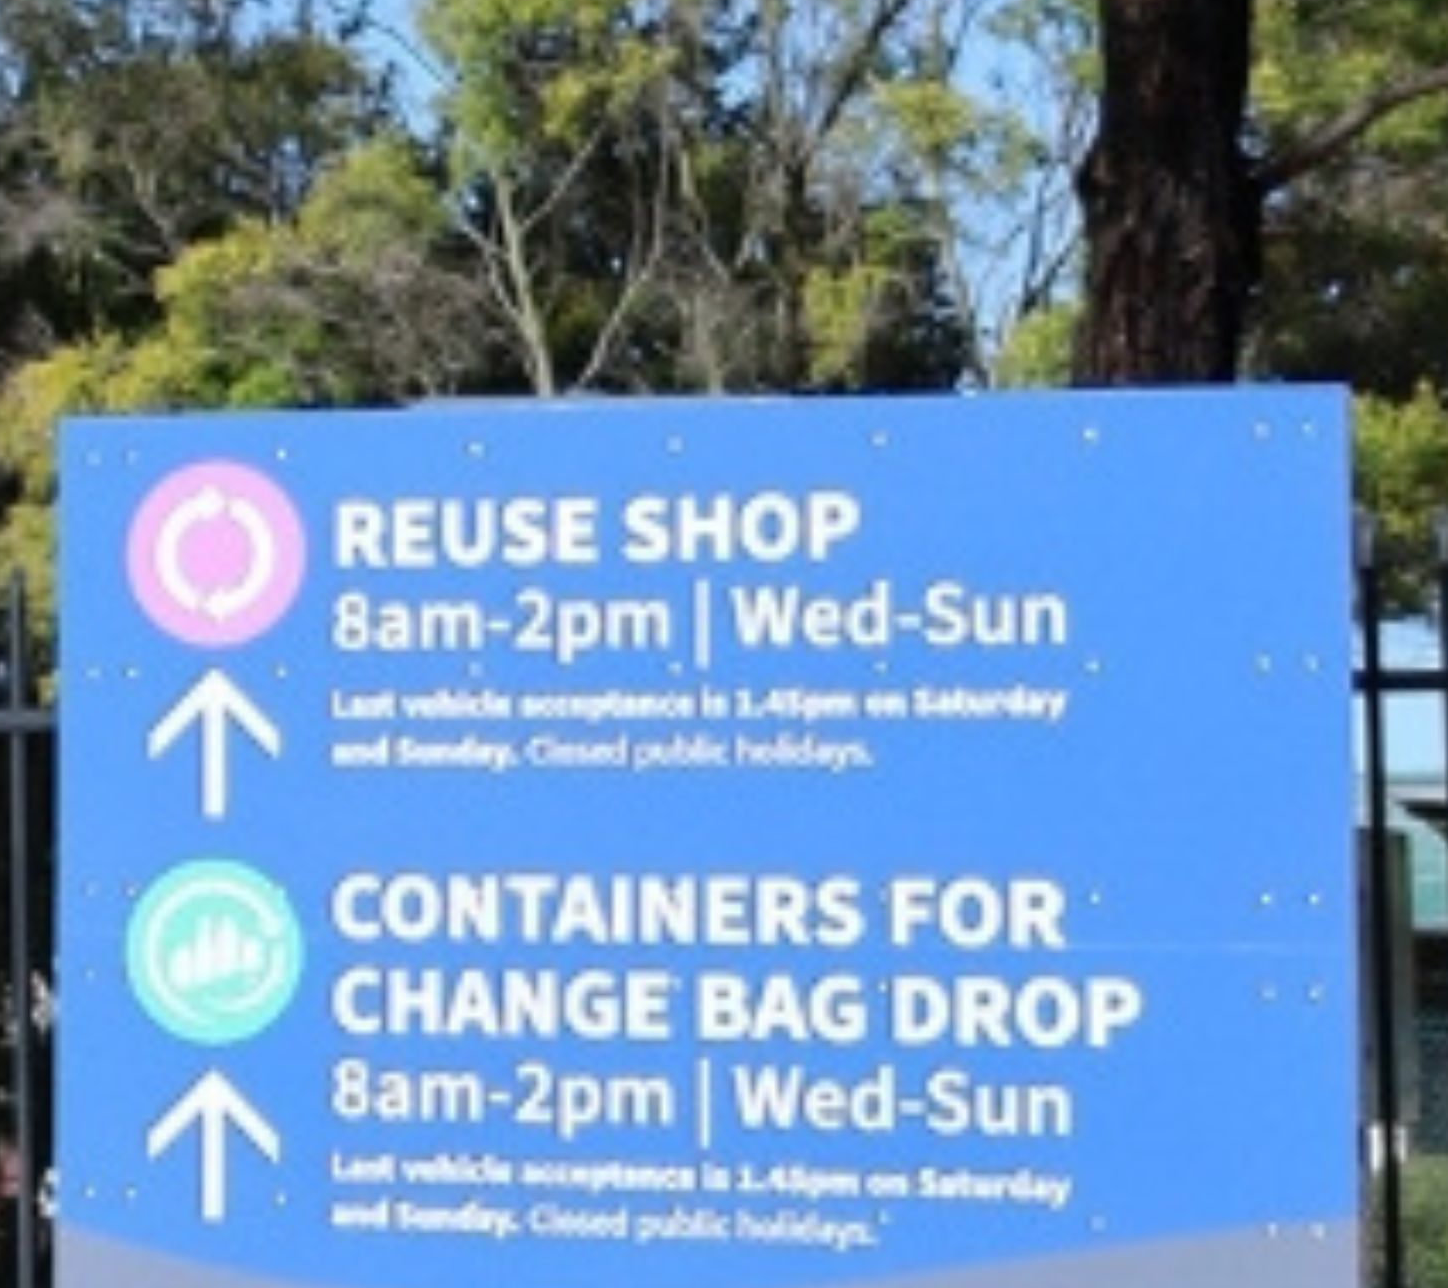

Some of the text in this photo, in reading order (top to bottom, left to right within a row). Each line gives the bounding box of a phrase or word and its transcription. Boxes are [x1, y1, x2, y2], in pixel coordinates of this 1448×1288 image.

[336, 491, 860, 568] REUSE SHOP
[333, 580, 1066, 663] 8am-2pm Wed-Sun
[331, 688, 394, 719] Last
[402, 687, 512, 719] vehicle
[519, 689, 691, 724] acceptance
[701, 684, 729, 718] is
[863, 692, 906, 718] on
[910, 683, 1066, 723] Saturday
[331, 730, 873, 774] and Sunday. Closed public holidays.
[333, 874, 1066, 949] CONTAINERS FOR
[333, 968, 1143, 1049] CHANGE BAG DROP
[333, 1061, 1071, 1140] 8am-2pm Wed-Sun
[332, 1154, 394, 1183] Last
[402, 1153, 512, 1184] vehicle
[520, 1159, 696, 1195] acceptance
[701, 1162, 730, 1191] is
[865, 1172, 909, 1197] on
[917, 1168, 1073, 1210] Saturday
[332, 1198, 876, 1251] and Sunday. Closed public holidays.
